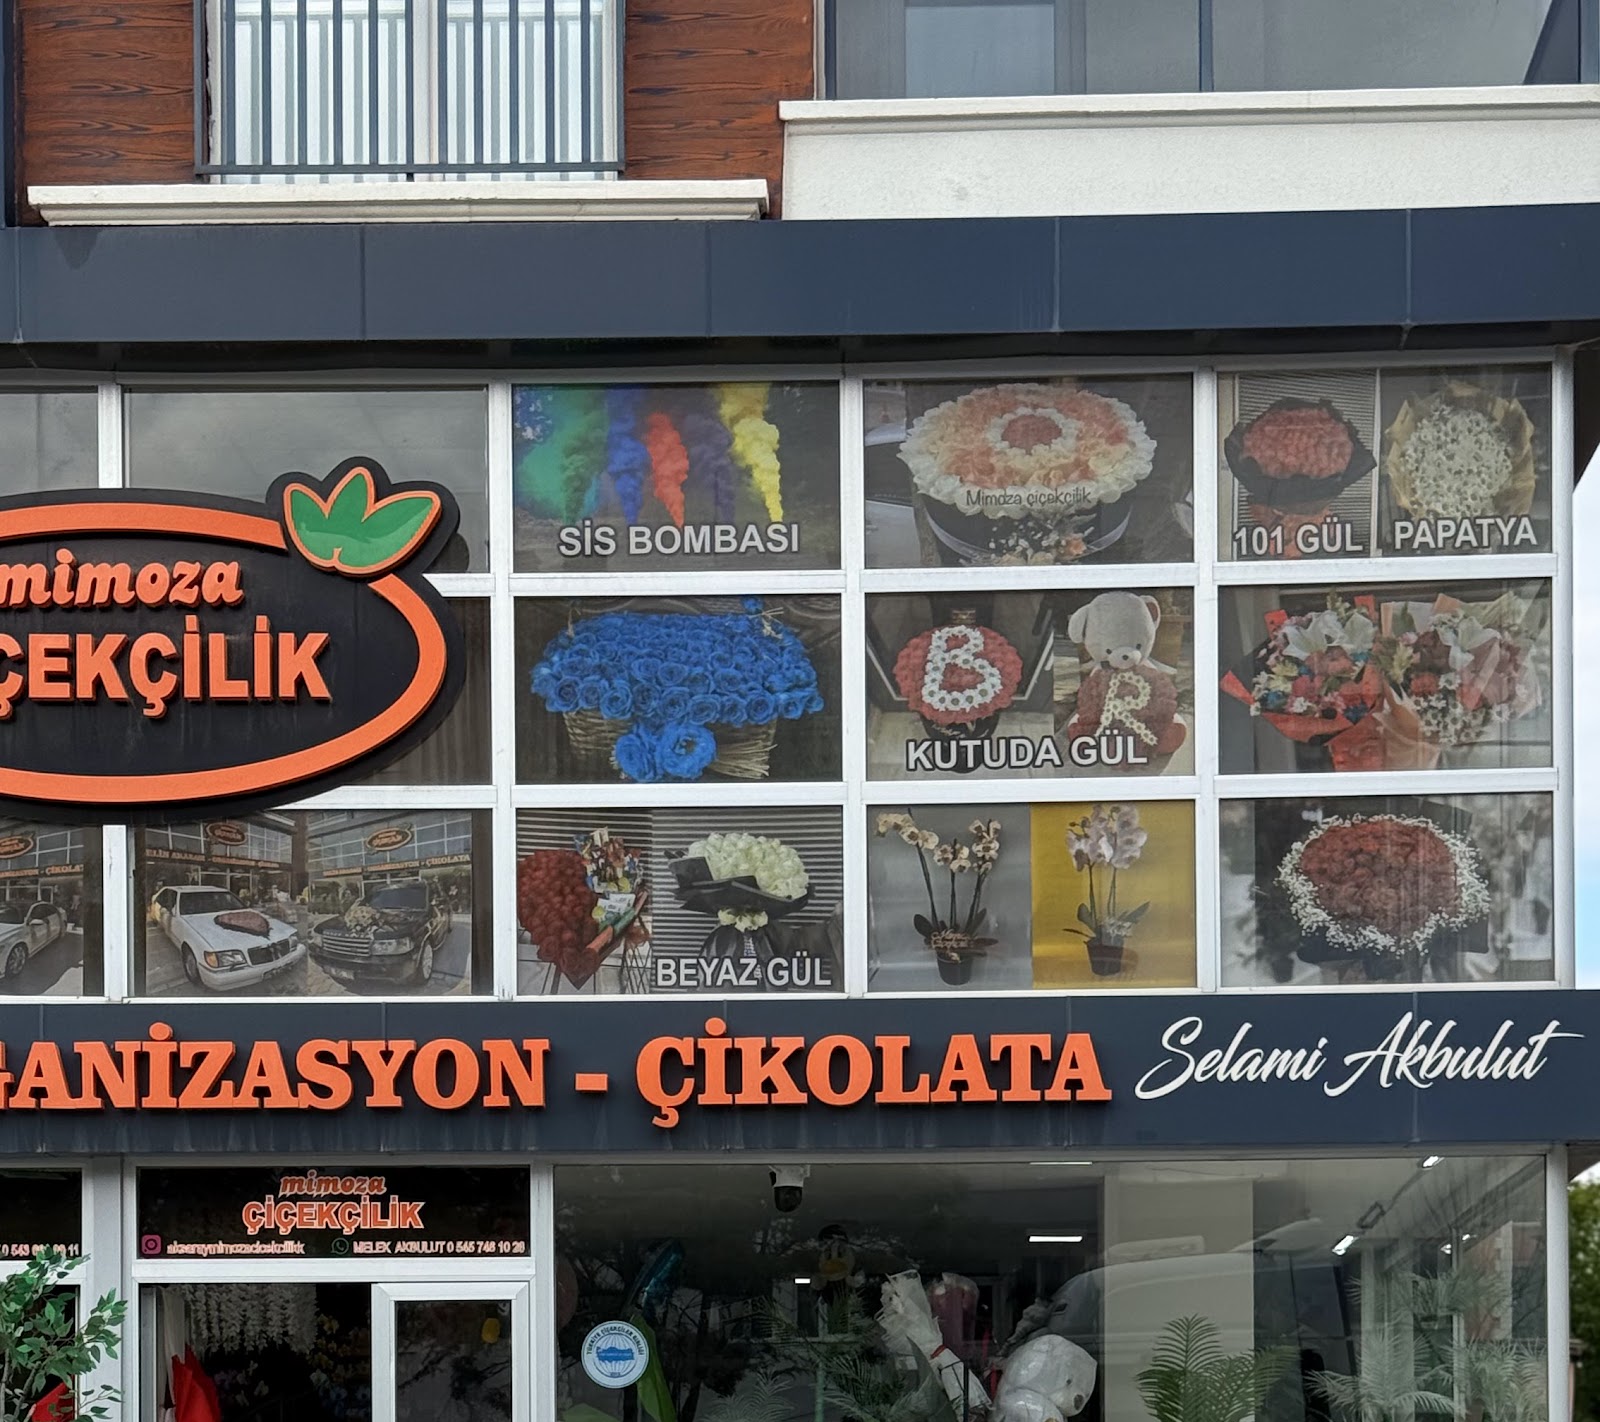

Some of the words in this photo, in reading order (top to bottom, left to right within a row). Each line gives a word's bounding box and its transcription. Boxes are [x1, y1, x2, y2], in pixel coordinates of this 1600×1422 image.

[966, 489, 1022, 506] Mimoza
[559, 519, 616, 556] SİS
[629, 524, 798, 555] BOMBASI
[1233, 525, 1285, 557] 101
[1297, 516, 1363, 554] GÜL
[1394, 516, 1538, 550] PAPATYA
[0, 549, 246, 608] mimoza
[906, 736, 1063, 771] KUTUDA
[1071, 728, 1148, 766] GÜL
[656, 957, 759, 987] BEYAZ
[767, 951, 832, 987] GÜL
[0, 1021, 551, 1111] ANİZASYON
[636, 1016, 1112, 1128] ÇİKOLATA
[1135, 1016, 1327, 1100] Selami
[1323, 1011, 1584, 1098] Akbulut
[278, 1169, 387, 1198] mimoza
[242, 1194, 425, 1235] ÇİÇEKÇİLİK
